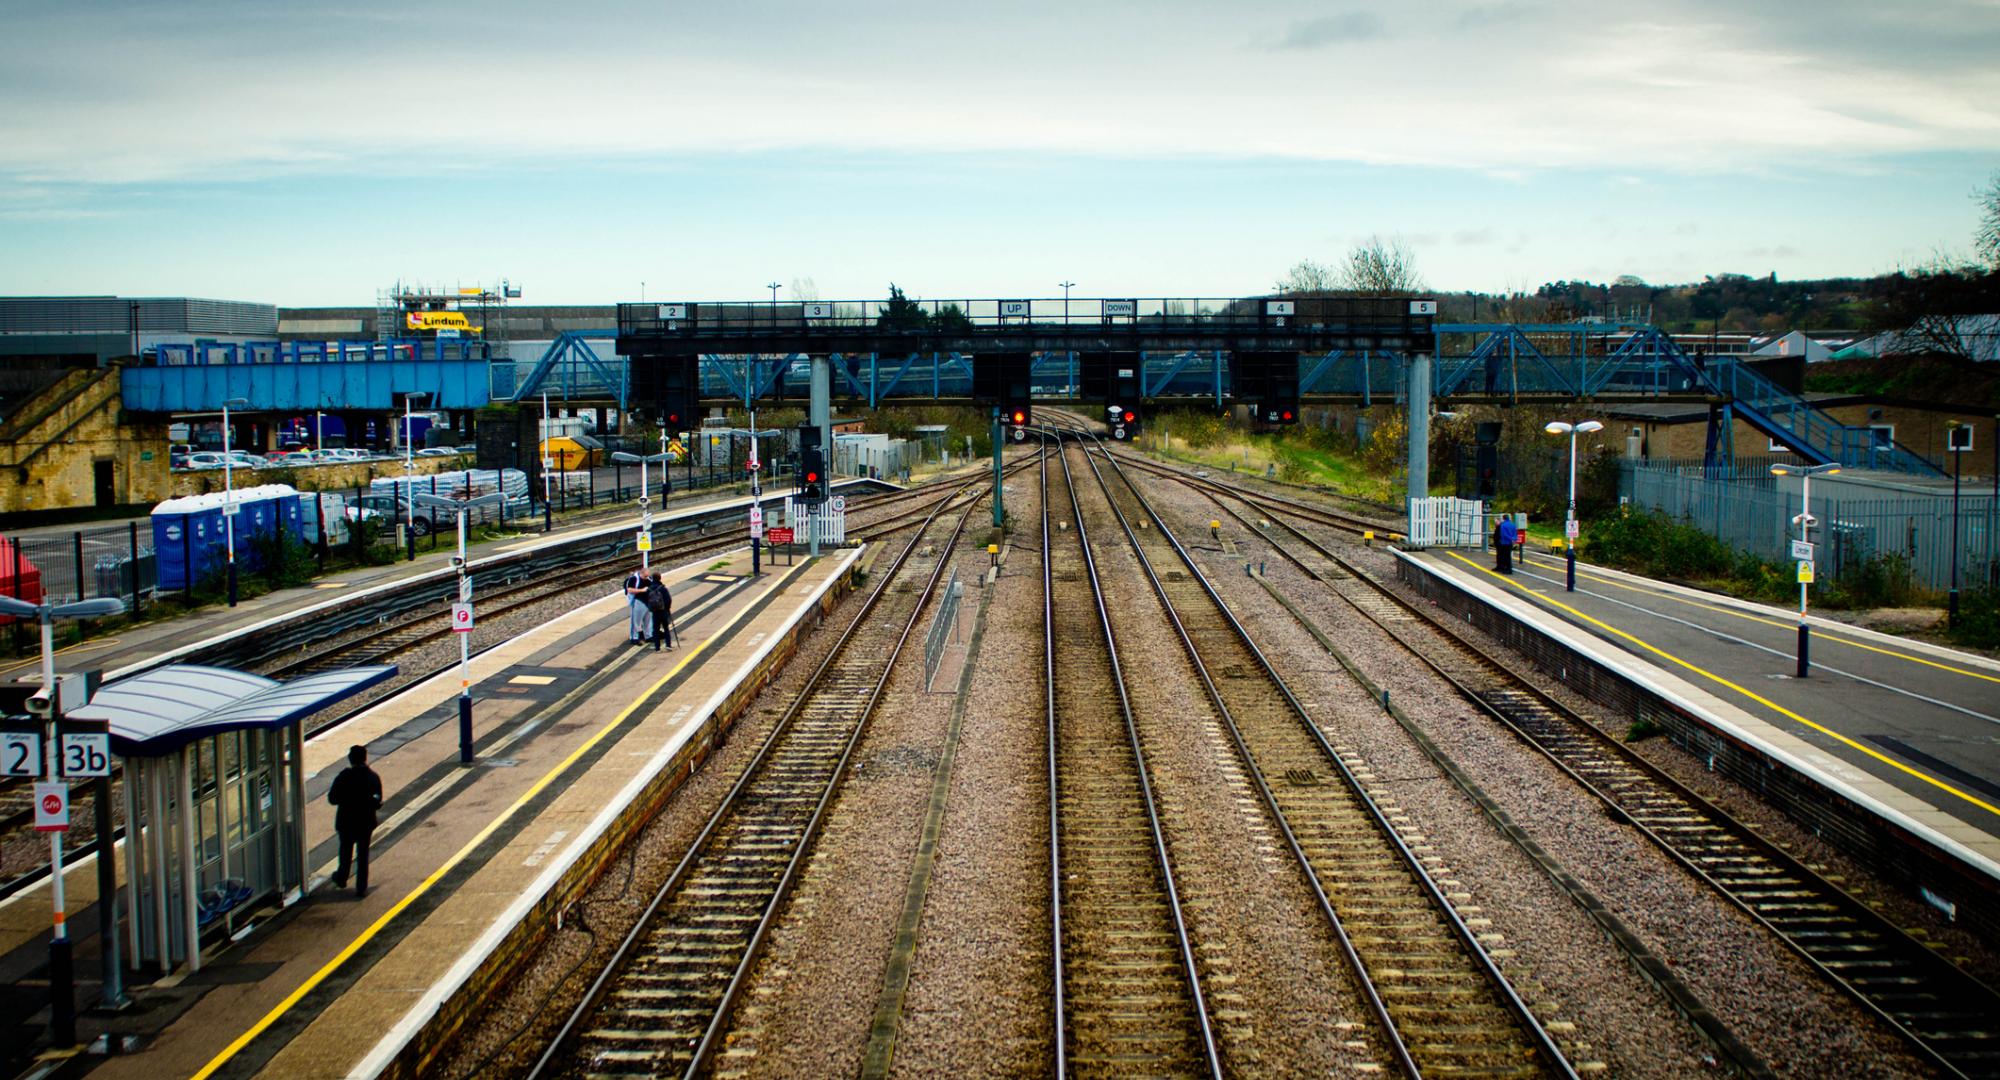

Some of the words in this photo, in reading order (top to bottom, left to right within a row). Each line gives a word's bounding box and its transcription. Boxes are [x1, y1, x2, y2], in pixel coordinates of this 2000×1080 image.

[814, 307, 821, 316] 3
[1007, 304, 1022, 313] UP
[1277, 303, 1285, 312] 4
[1420, 303, 1428, 312] 5
[669, 308, 676, 317] 2
[423, 317, 465, 326] Lindum
[8, 742, 30, 775] 2
[66, 744, 107, 772] 3b
